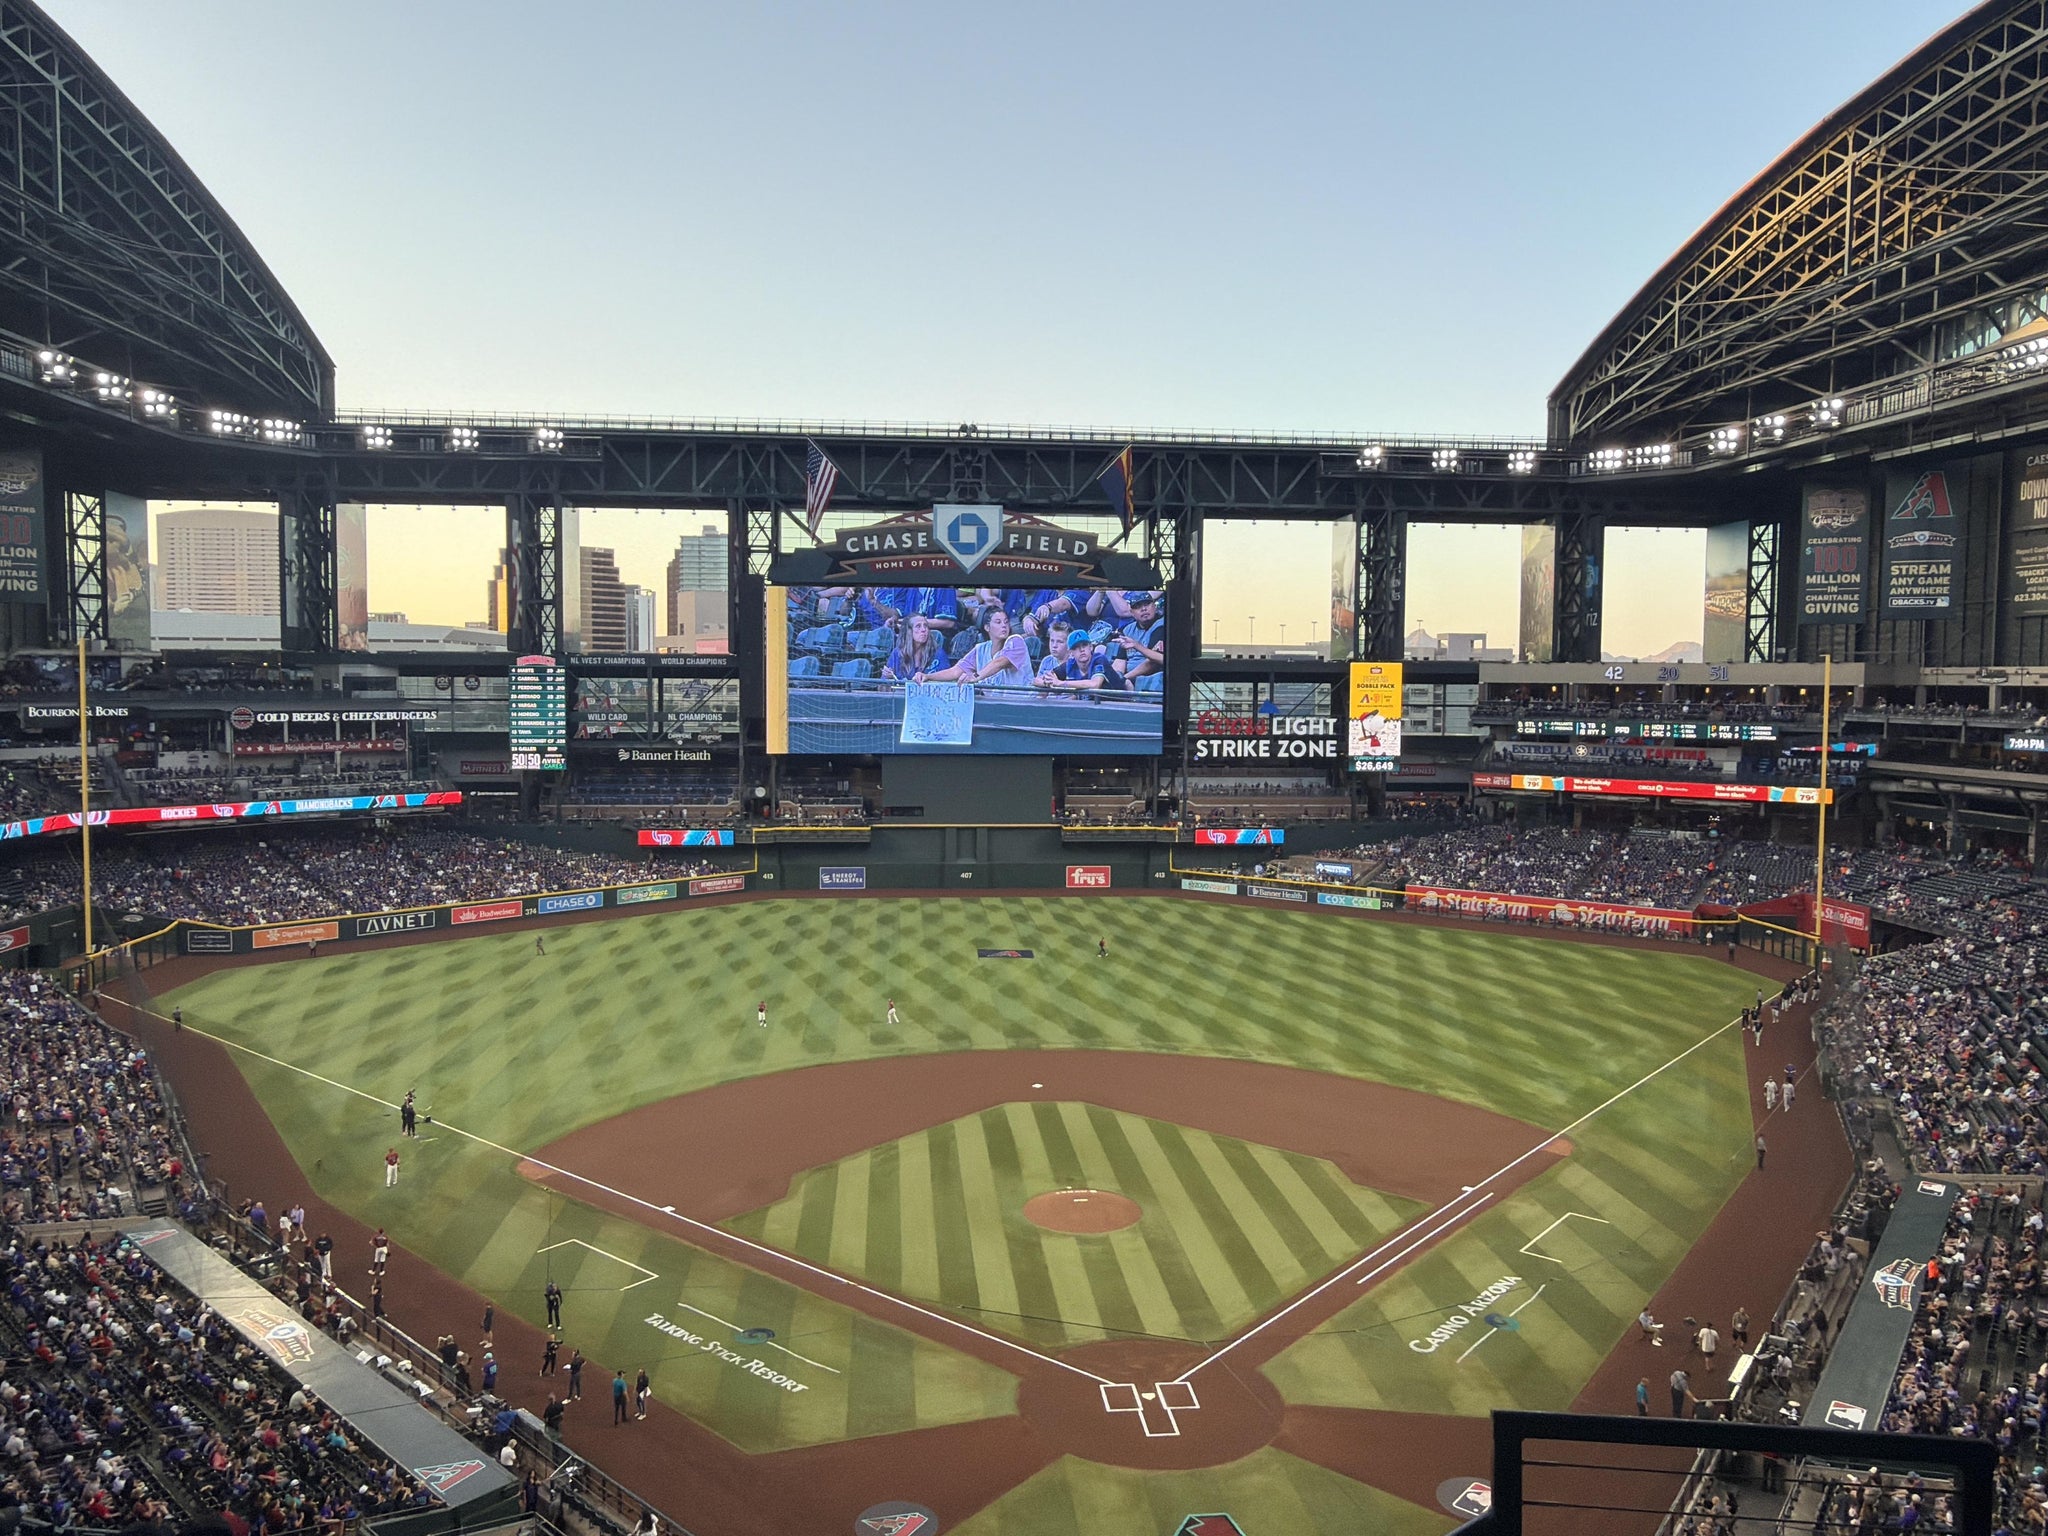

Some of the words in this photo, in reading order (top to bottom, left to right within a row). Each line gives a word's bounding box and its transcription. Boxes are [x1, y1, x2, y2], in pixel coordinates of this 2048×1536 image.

[846, 532, 928, 553] CHASE
[1008, 533, 1088, 556] FIELD
[911, 559, 923, 567] OF
[931, 559, 950, 567] THE
[986, 560, 1060, 573] DIAMONDBACKS
[1890, 564, 1951, 575] STREAM
[1806, 574, 1861, 584] MILLION
[1890, 577, 1914, 585] ANY
[1918, 576, 1950, 584] GAME
[1889, 587, 1950, 595] ANYWHERE
[1805, 594, 1860, 602] CHARITABLE
[1805, 603, 1859, 614] GIVING
[582, 657, 601, 665] WEST
[603, 657, 646, 665] CHAMPIONS
[1605, 666, 1623, 680] 42
[1657, 666, 1680, 681] 20
[1709, 666, 1729, 681] 51
[256, 713, 289, 722] COLD
[292, 712, 330, 722] BEERS
[332, 712, 340, 721] &
[342, 711, 437, 721] CHEESEBURGERS
[1196, 708, 1268, 736] Coors
[1272, 716, 1337, 735] LIGHT
[1196, 740, 1270, 757] STRIKE
[1277, 740, 1337, 757] ZONE
[2009, 738, 2028, 748] 7:04
[2030, 739, 2045, 749] PM
[632, 750, 673, 760] Banner
[674, 750, 711, 760] Health
[1512, 745, 1573, 755] ESTRELLA
[1355, 760, 1393, 771] $26,649
[161, 808, 197, 819] ROCKIES
[296, 798, 353, 811] DIAMONDBACKS
[1071, 868, 1106, 885] fry's
[1259, 888, 1281, 897] Banner
[1282, 890, 1303, 900] Health
[546, 897, 585, 911] CHASE
[1325, 896, 1345, 905] COX
[1352, 897, 1373, 907] COX
[1382, 901, 1394, 909] 374
[479, 908, 516, 919] Budweiser
[525, 907, 537, 916] 374
[365, 913, 427, 932] AVNET
[281, 929, 304, 938] Dignity
[305, 927, 325, 935] Health
[1409, 1314, 1470, 1353] CASINO
[1457, 1275, 1522, 1317] ARIZONA
[643, 1312, 703, 1346] TALKING
[701, 1341, 747, 1366] STICK
[742, 1358, 810, 1393] RESORT
